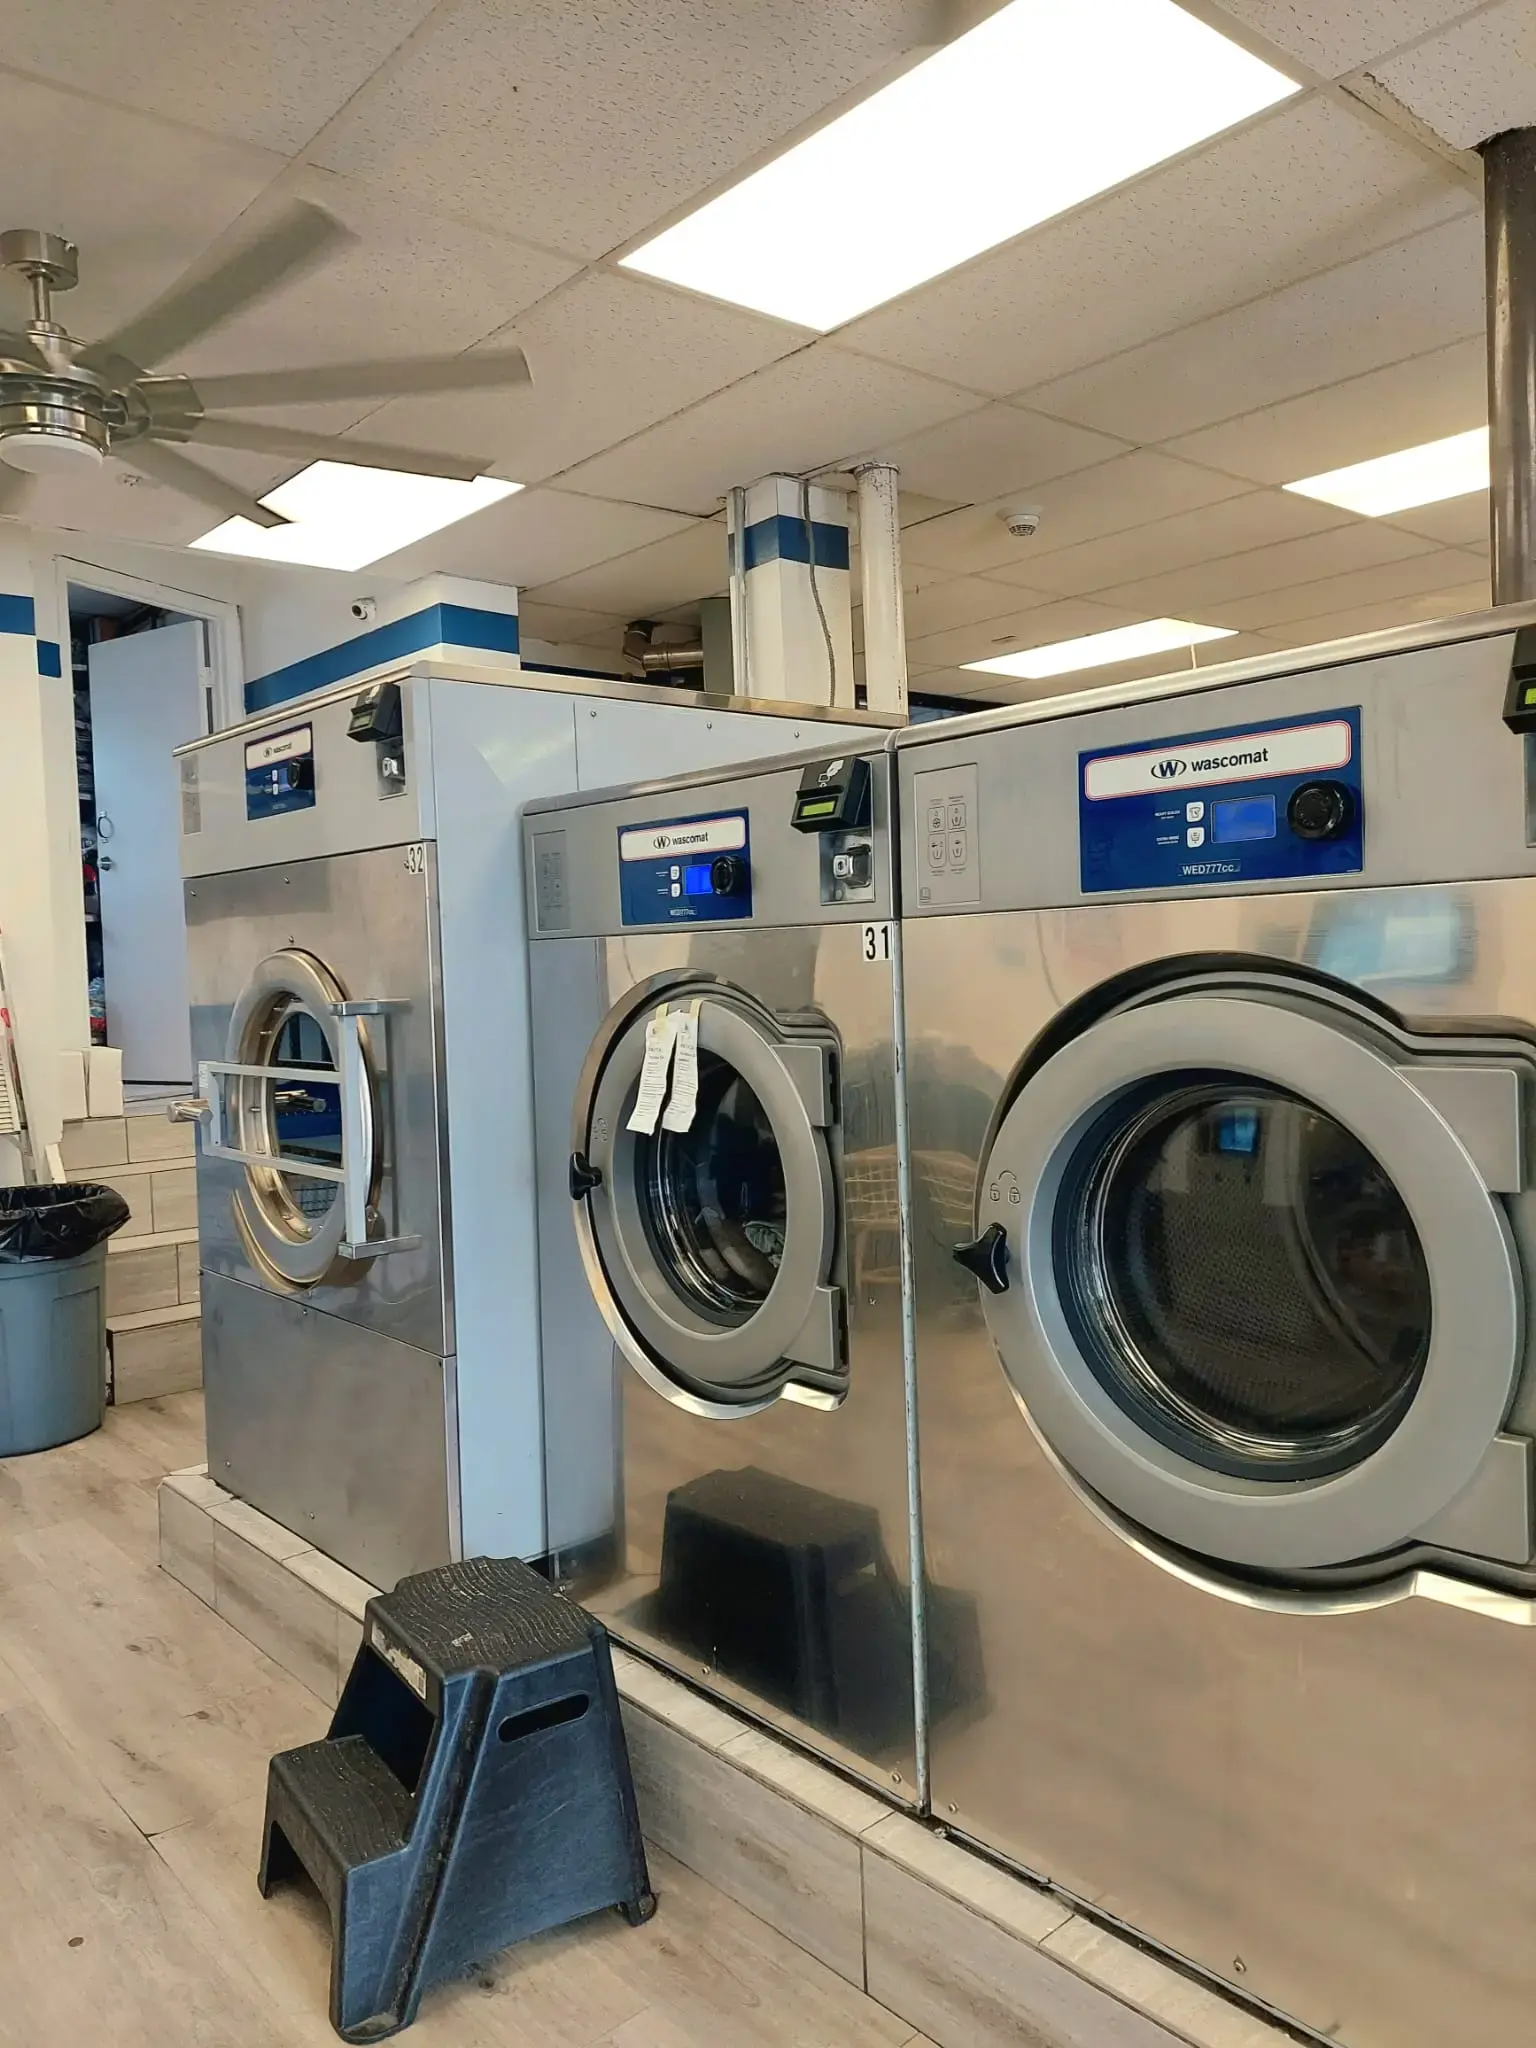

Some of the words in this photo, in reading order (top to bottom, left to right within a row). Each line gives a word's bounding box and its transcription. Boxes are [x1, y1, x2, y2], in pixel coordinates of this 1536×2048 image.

[1191, 748, 1269, 772] wascomat
[672, 832, 709, 846] wascomat
[409, 846, 423, 873] 32
[1182, 863, 1235, 876] WED777cc
[864, 925, 890, 960] 31
